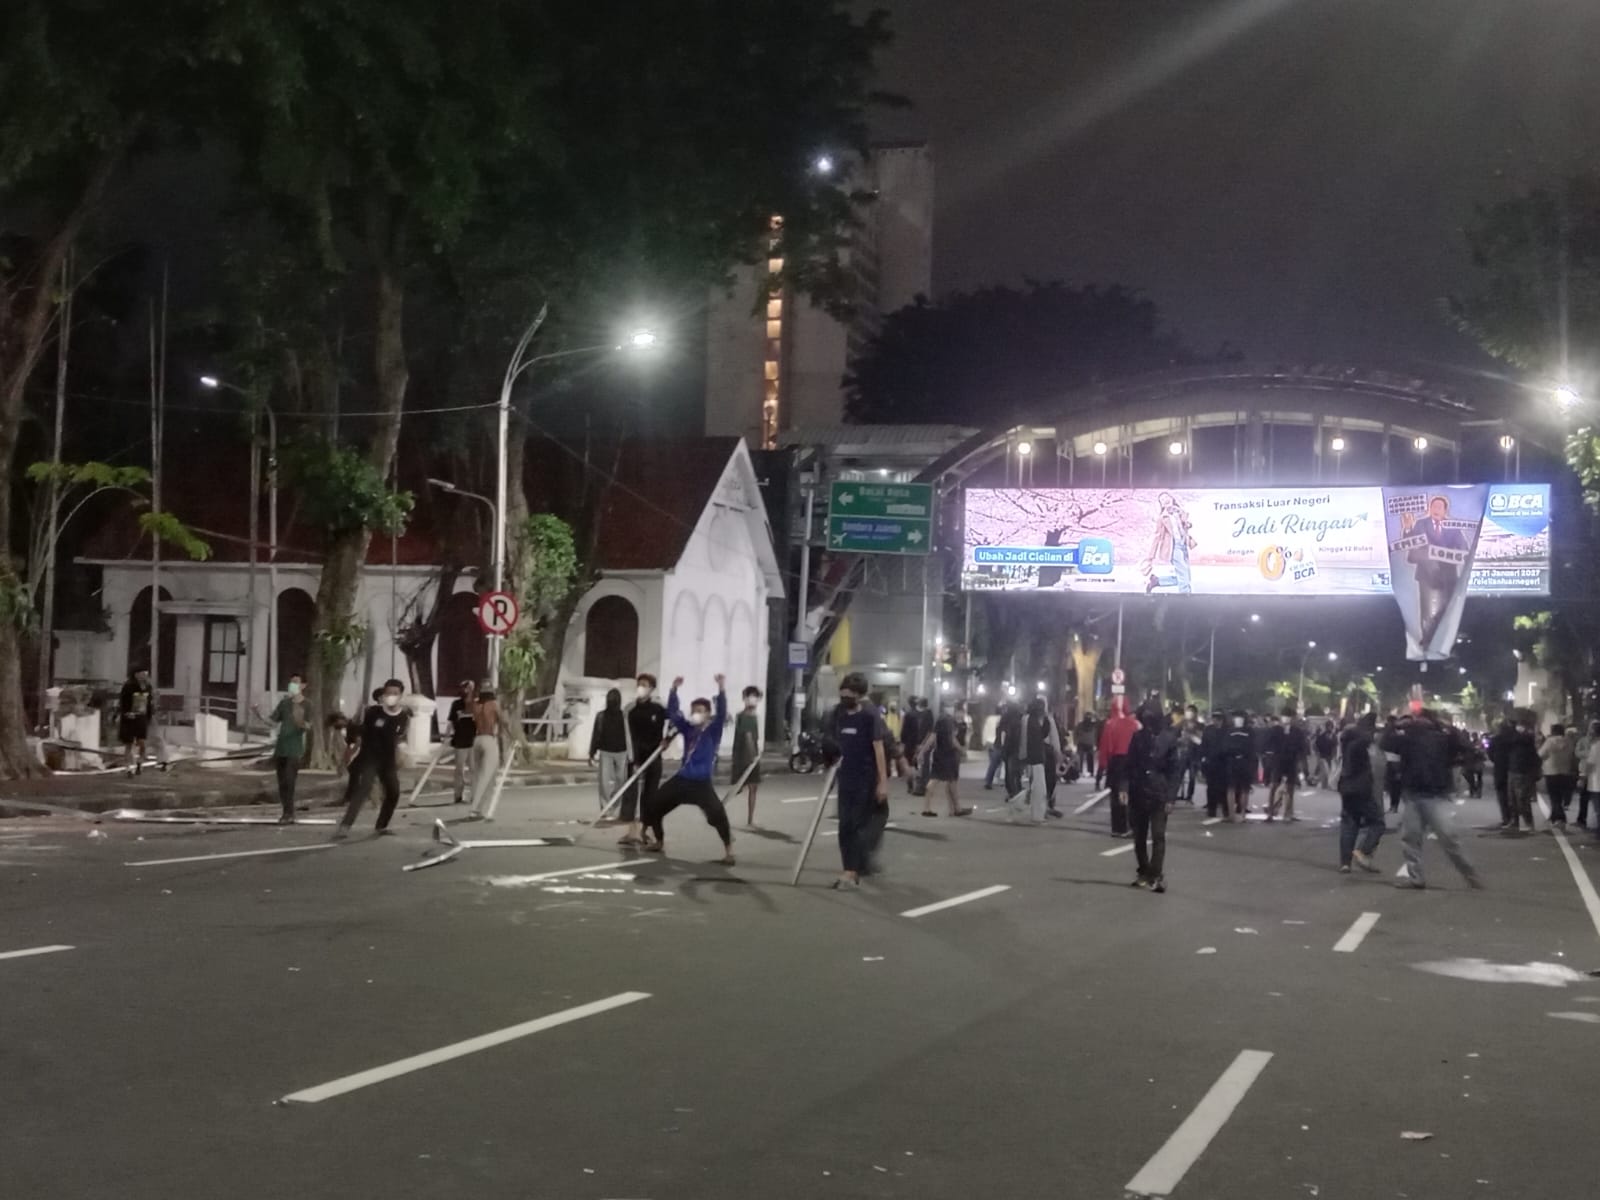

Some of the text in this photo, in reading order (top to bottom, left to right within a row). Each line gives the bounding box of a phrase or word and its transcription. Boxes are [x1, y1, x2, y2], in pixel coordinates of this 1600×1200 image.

[1214, 495, 1330, 511] Transaksi Luar Negeri
[1508, 494, 1543, 508] BCA
[1232, 513, 1353, 542] Jadi Ringan
[980, 552, 1074, 561] Ubah Jadi Cicilan di
[1081, 553, 1110, 565] BCA
